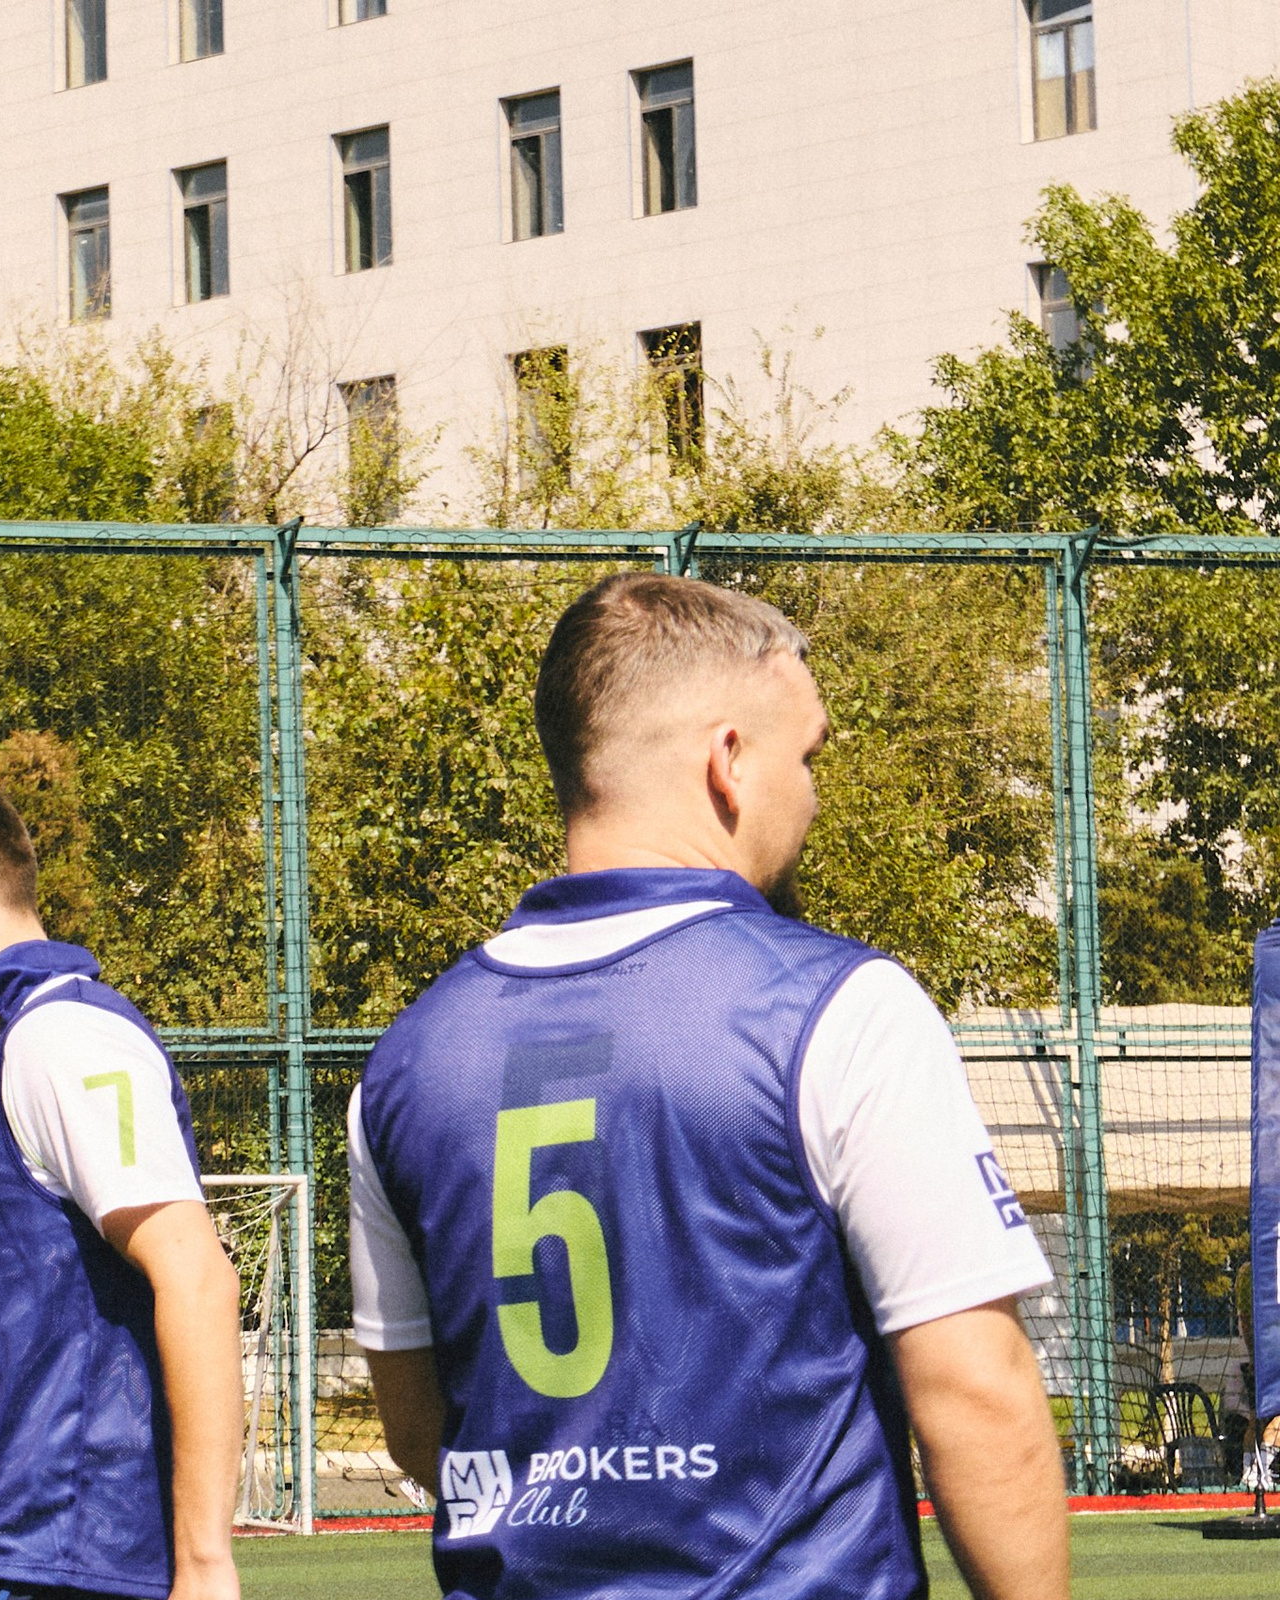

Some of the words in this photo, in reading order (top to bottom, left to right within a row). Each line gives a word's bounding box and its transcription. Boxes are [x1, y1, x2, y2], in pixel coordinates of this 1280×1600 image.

[81, 1070, 136, 1167] 7
[493, 1098, 613, 1398] 5
[526, 1443, 719, 1485] BROKERS
[507, 1486, 587, 1527] Club
